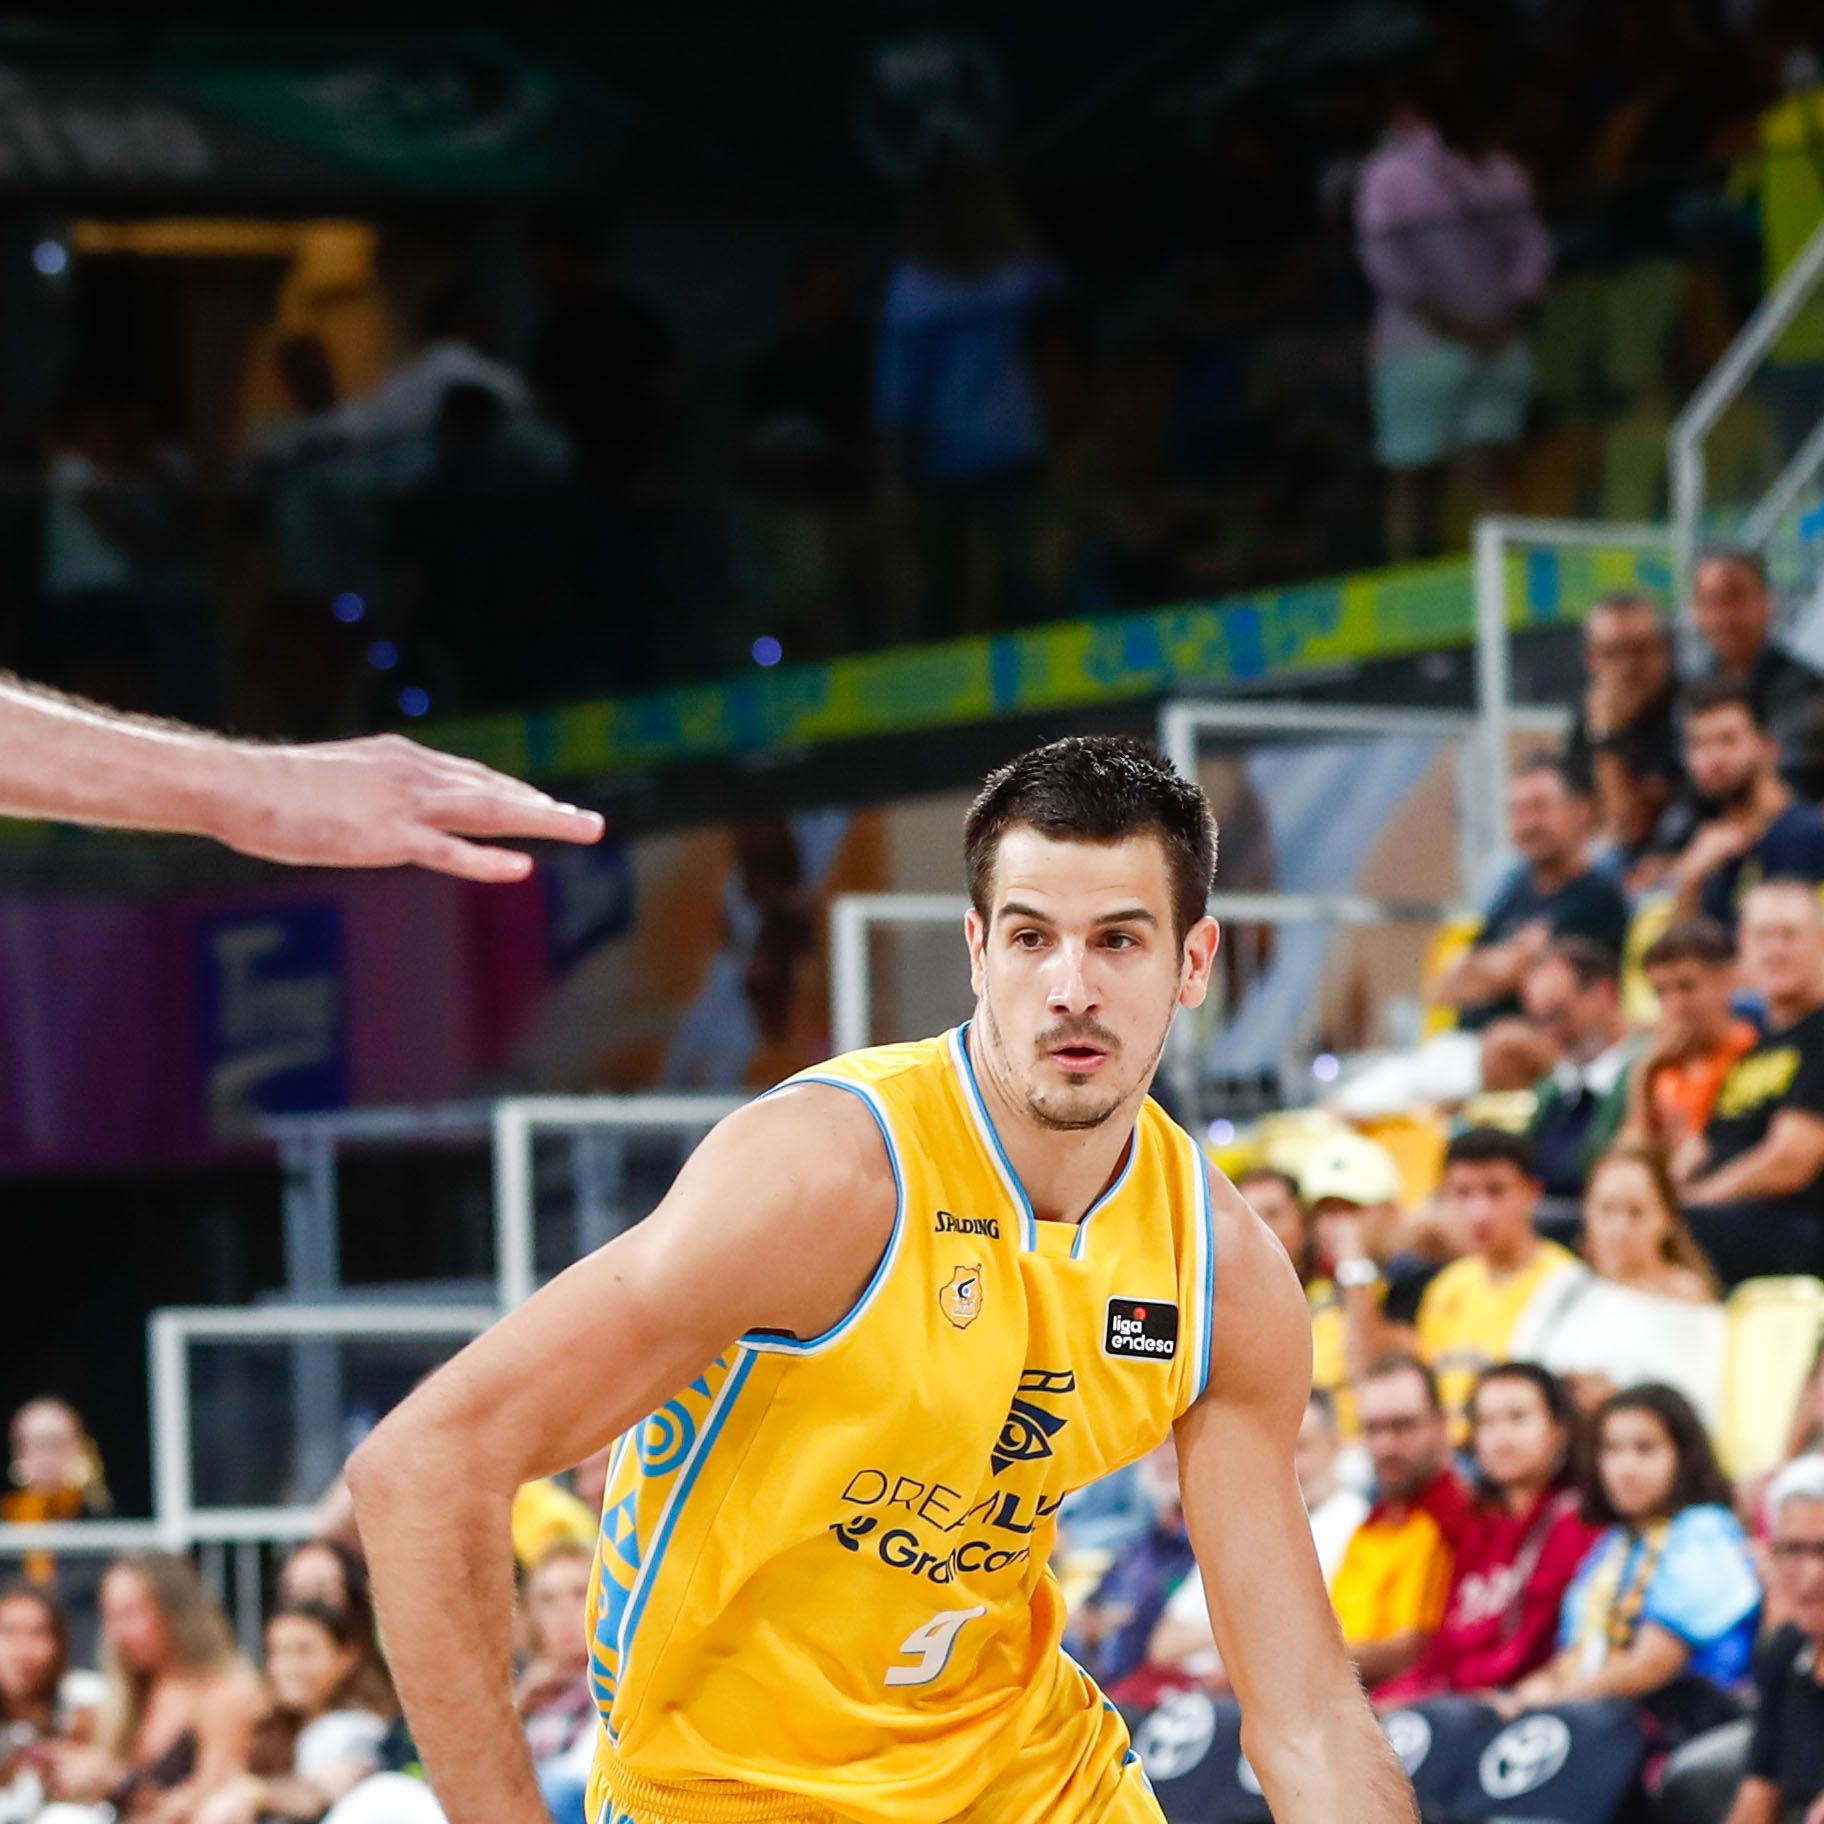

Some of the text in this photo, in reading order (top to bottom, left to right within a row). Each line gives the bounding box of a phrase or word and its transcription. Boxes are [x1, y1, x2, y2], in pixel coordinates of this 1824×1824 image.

[1112, 1314, 1143, 1335] liga
[1111, 1334, 1175, 1354] endesa
[883, 1605, 987, 1687] 9
